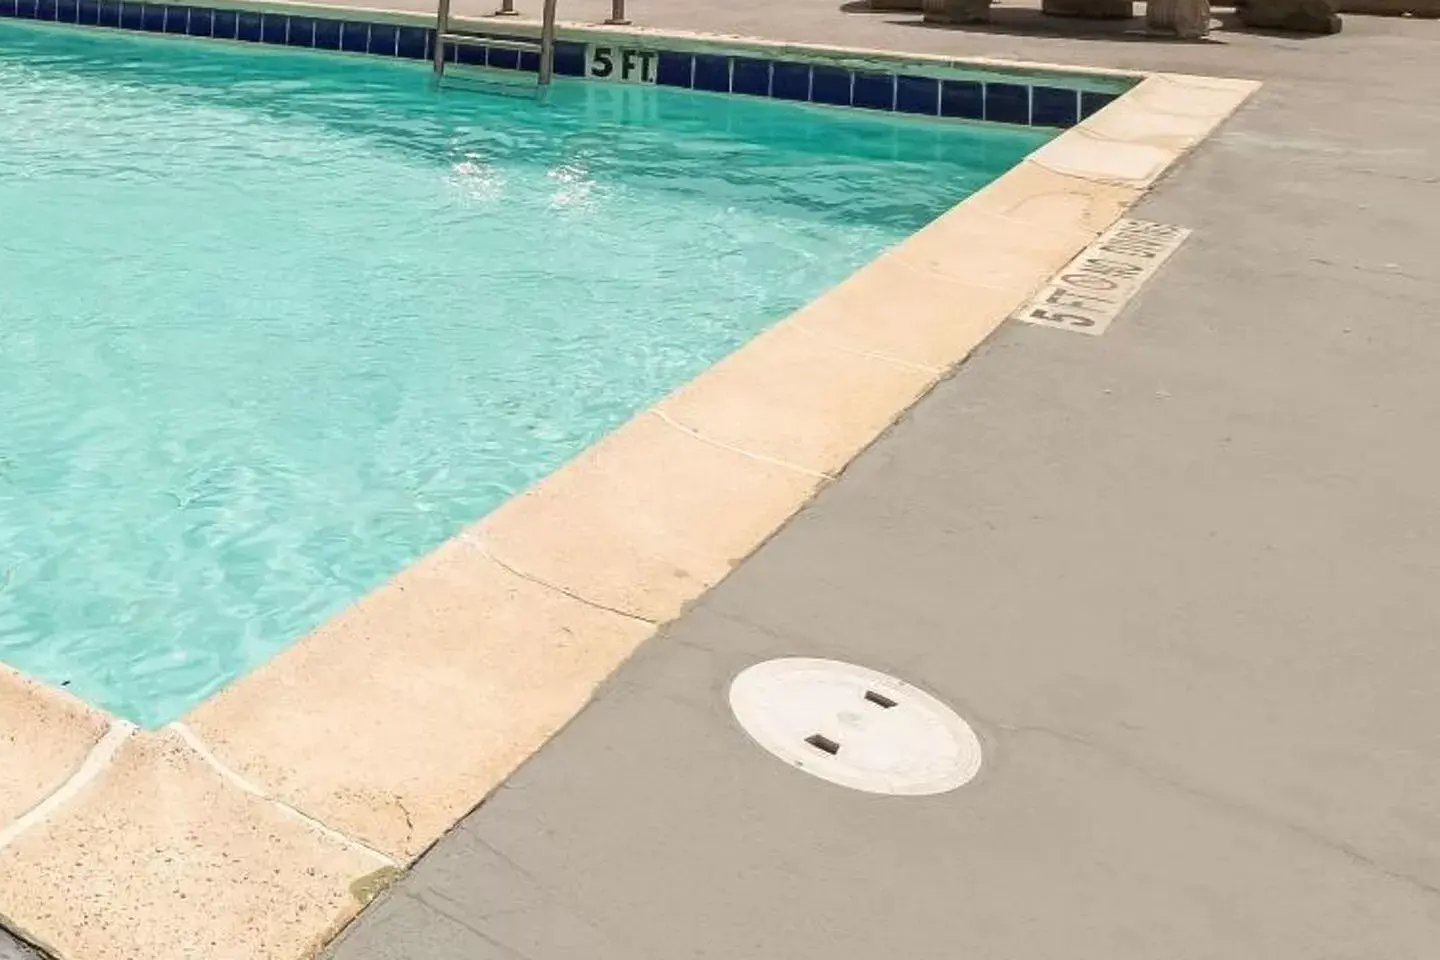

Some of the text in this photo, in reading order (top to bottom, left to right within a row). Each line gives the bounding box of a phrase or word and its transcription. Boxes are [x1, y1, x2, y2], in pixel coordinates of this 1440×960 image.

[591, 48, 613, 77] 5
[1046, 288, 1118, 314] FT
[1030, 309, 1095, 327] 5
